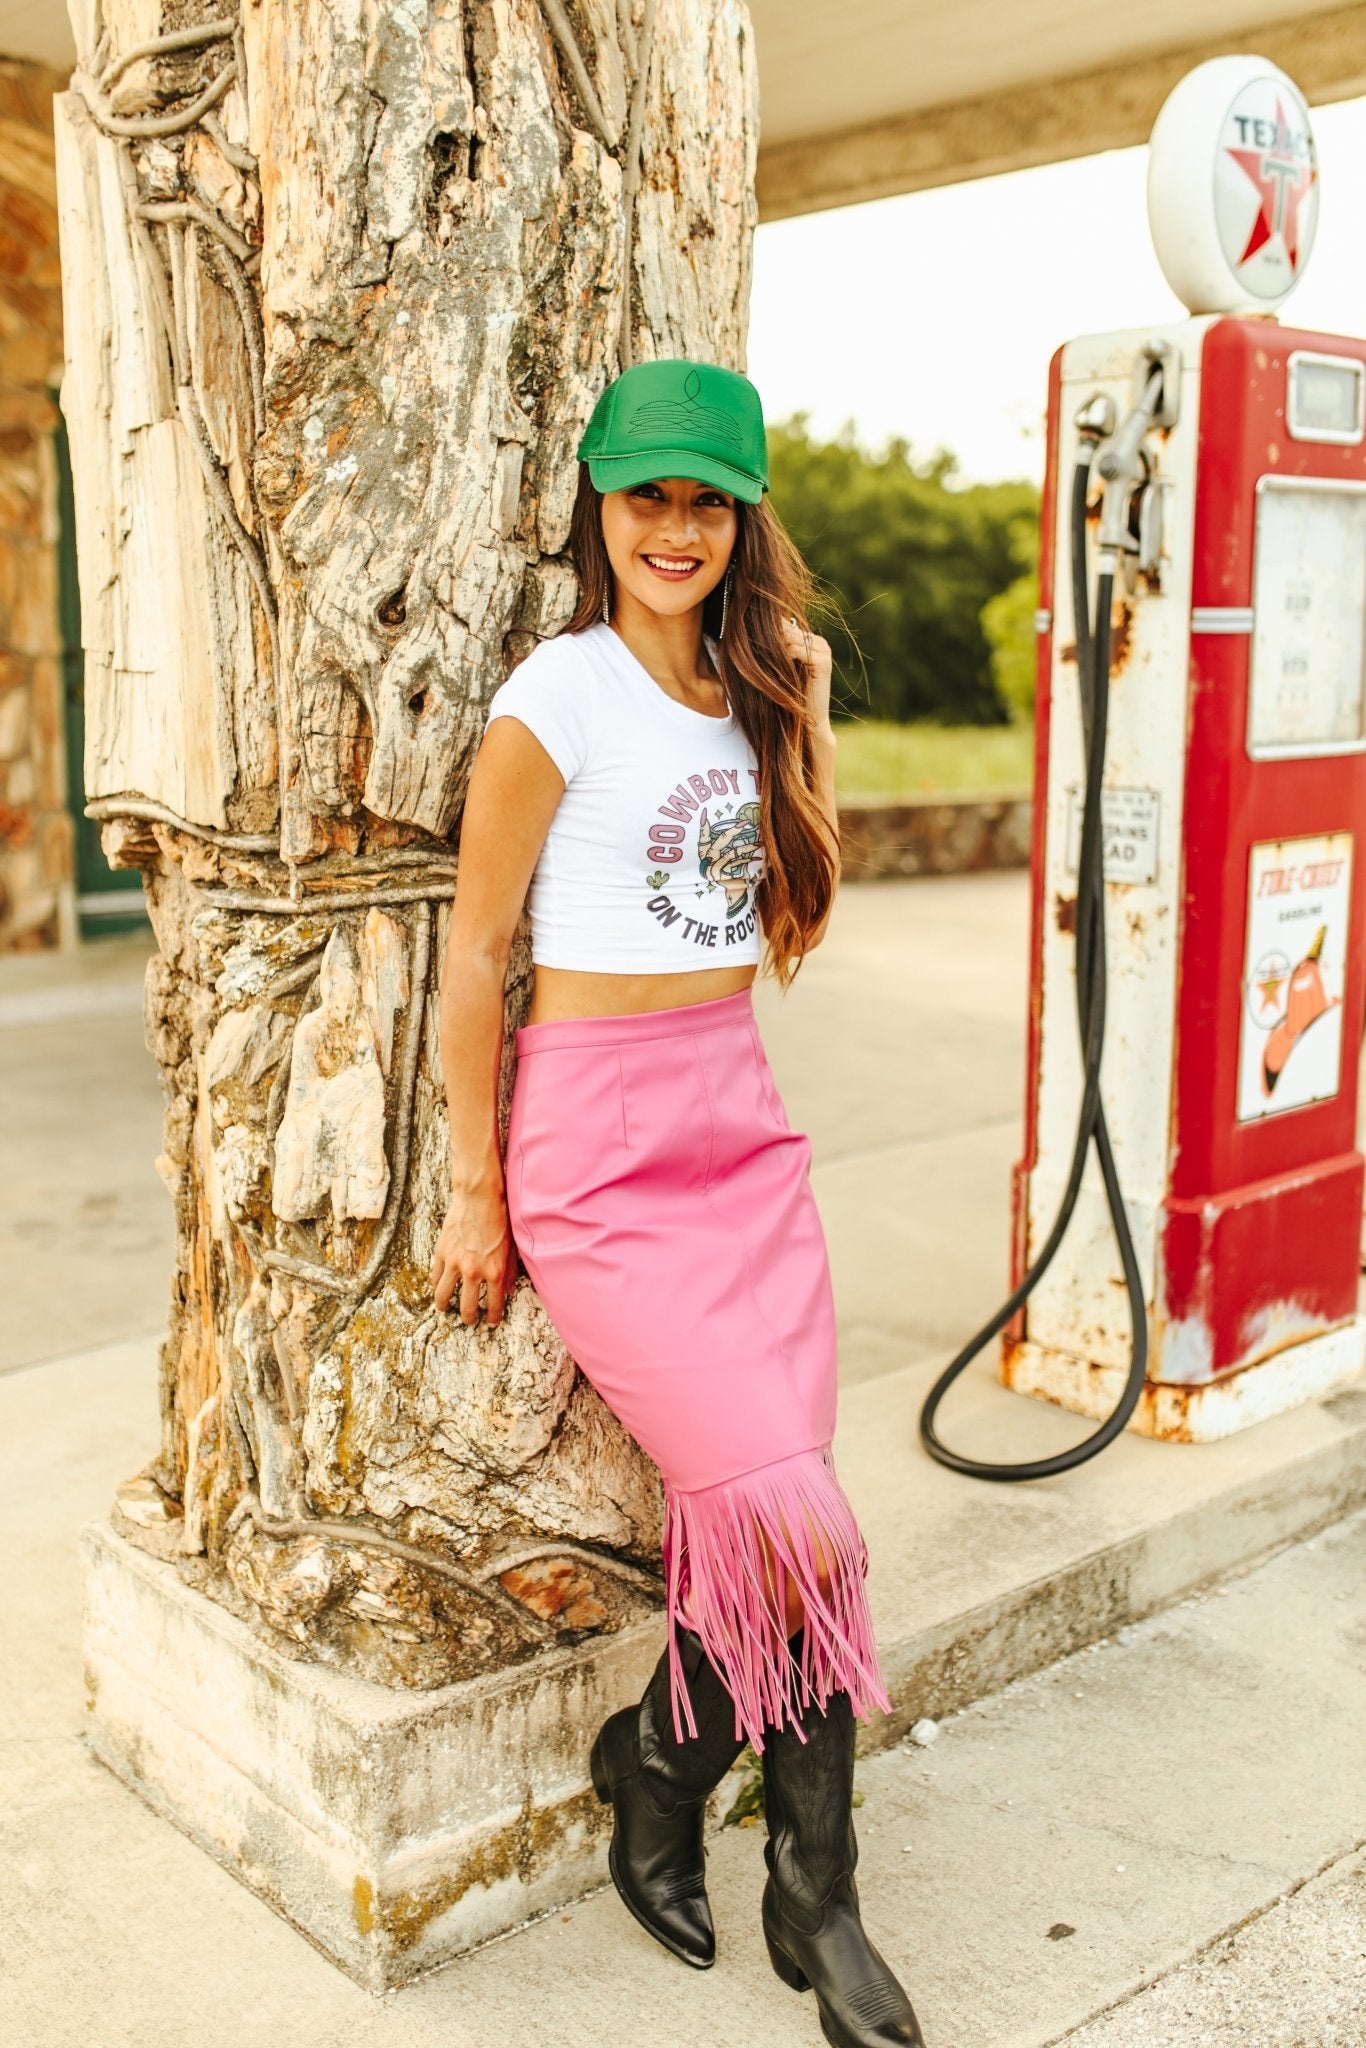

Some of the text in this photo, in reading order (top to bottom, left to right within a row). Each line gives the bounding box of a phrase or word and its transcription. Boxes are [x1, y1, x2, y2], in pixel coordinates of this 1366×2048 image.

[647, 768, 740, 864] COWBOY
[646, 895, 757, 947] ON THE ROCK
